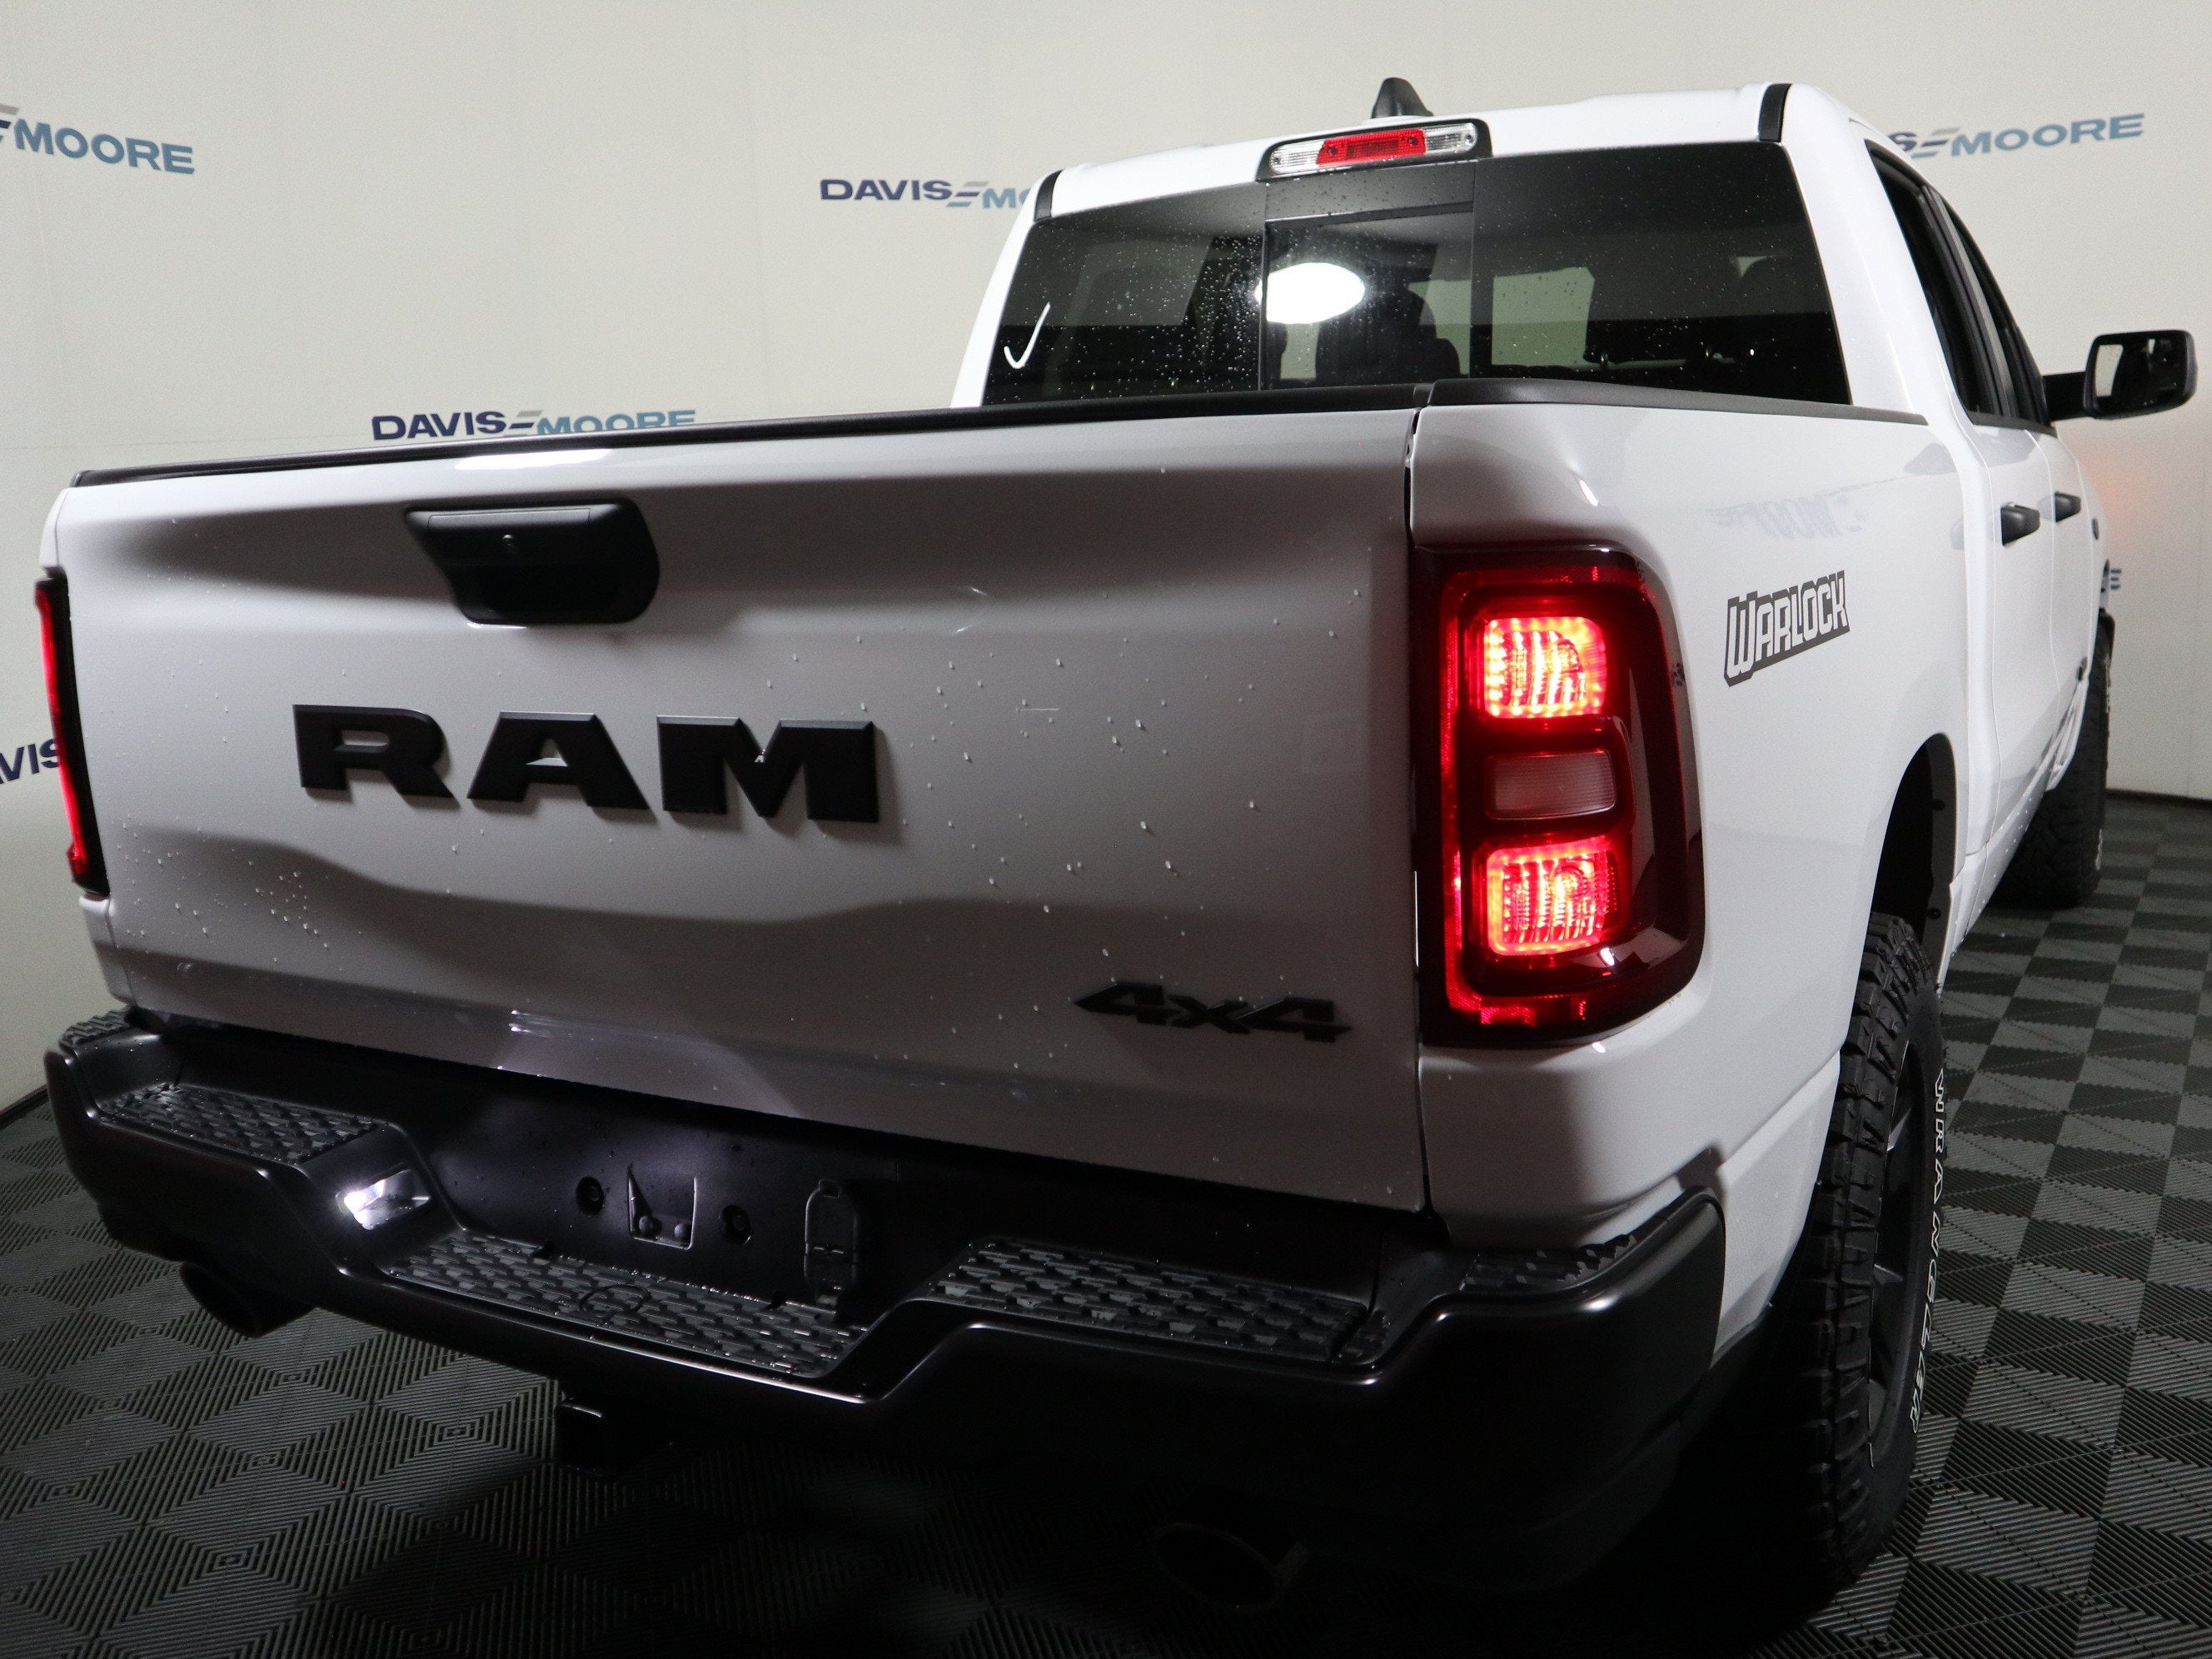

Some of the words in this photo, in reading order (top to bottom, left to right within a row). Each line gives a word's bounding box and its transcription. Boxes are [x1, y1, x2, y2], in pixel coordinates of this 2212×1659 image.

[13, 118, 195, 174] MOORE
[1950, 112, 2145, 157] MOORE
[820, 179, 953, 200] DAVIS
[371, 411, 506, 441] DAVIS
[536, 409, 696, 436] MOORE
[1724, 570, 1851, 687] WARLOCK
[0, 738, 58, 785] VIS
[292, 704, 880, 823] RAM
[1910, 1069, 1945, 1433] WRANGLER
